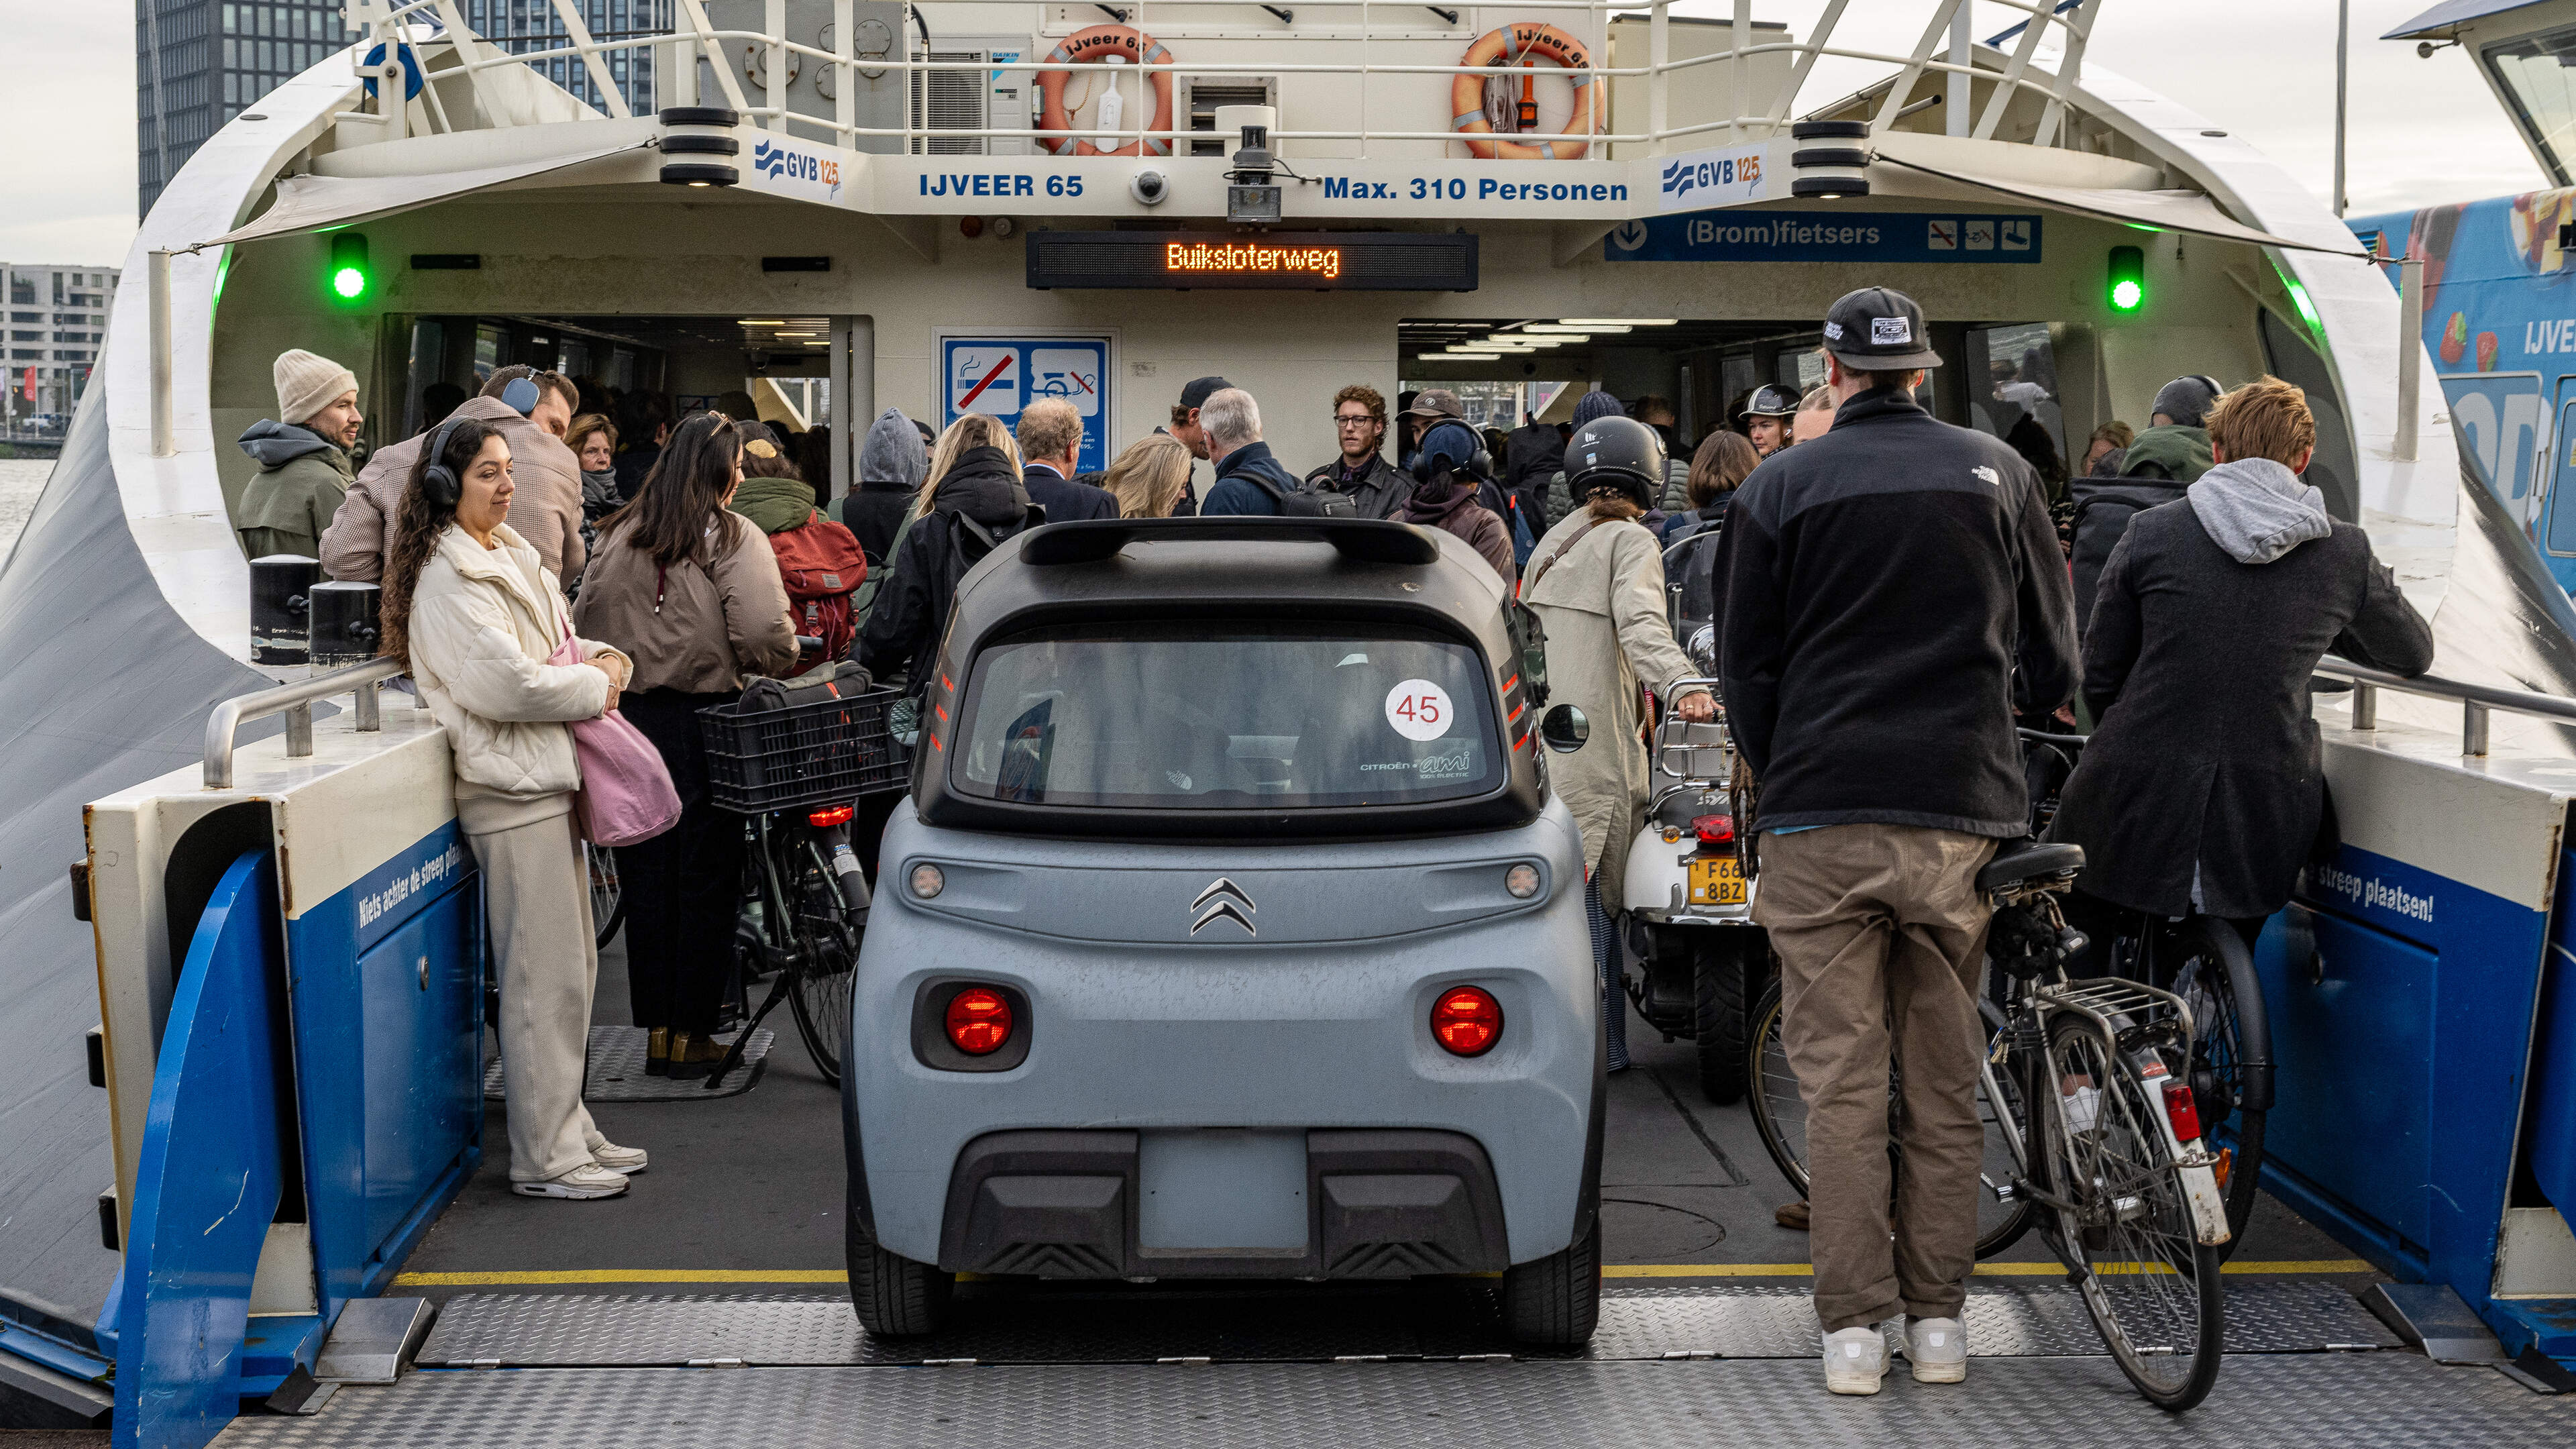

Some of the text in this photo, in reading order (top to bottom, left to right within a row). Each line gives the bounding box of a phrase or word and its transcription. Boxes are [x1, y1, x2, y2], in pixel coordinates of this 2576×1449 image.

[1065, 34, 1121, 56] IJveer
[786, 152, 839, 186] GVB 125
[1697, 155, 1760, 188] GVB 125
[920, 174, 1084, 197] IJVEER 65
[1326, 177, 1628, 202] Max. 310 Personen
[1686, 219, 1880, 248] (Brom)fietsers
[1167, 243, 1340, 278] Buiksloterweg
[1396, 694, 1440, 724] 45
[1360, 750, 1471, 774] CITROËN ami
[359, 892, 382, 929] Niets
[382, 877, 409, 913] achter
[410, 867, 421, 894] de
[421, 853, 444, 887] streep
[1708, 882, 1742, 900] 8BZ
[2318, 863, 2362, 903] streep
[2364, 877, 2434, 923] plaatsen!
